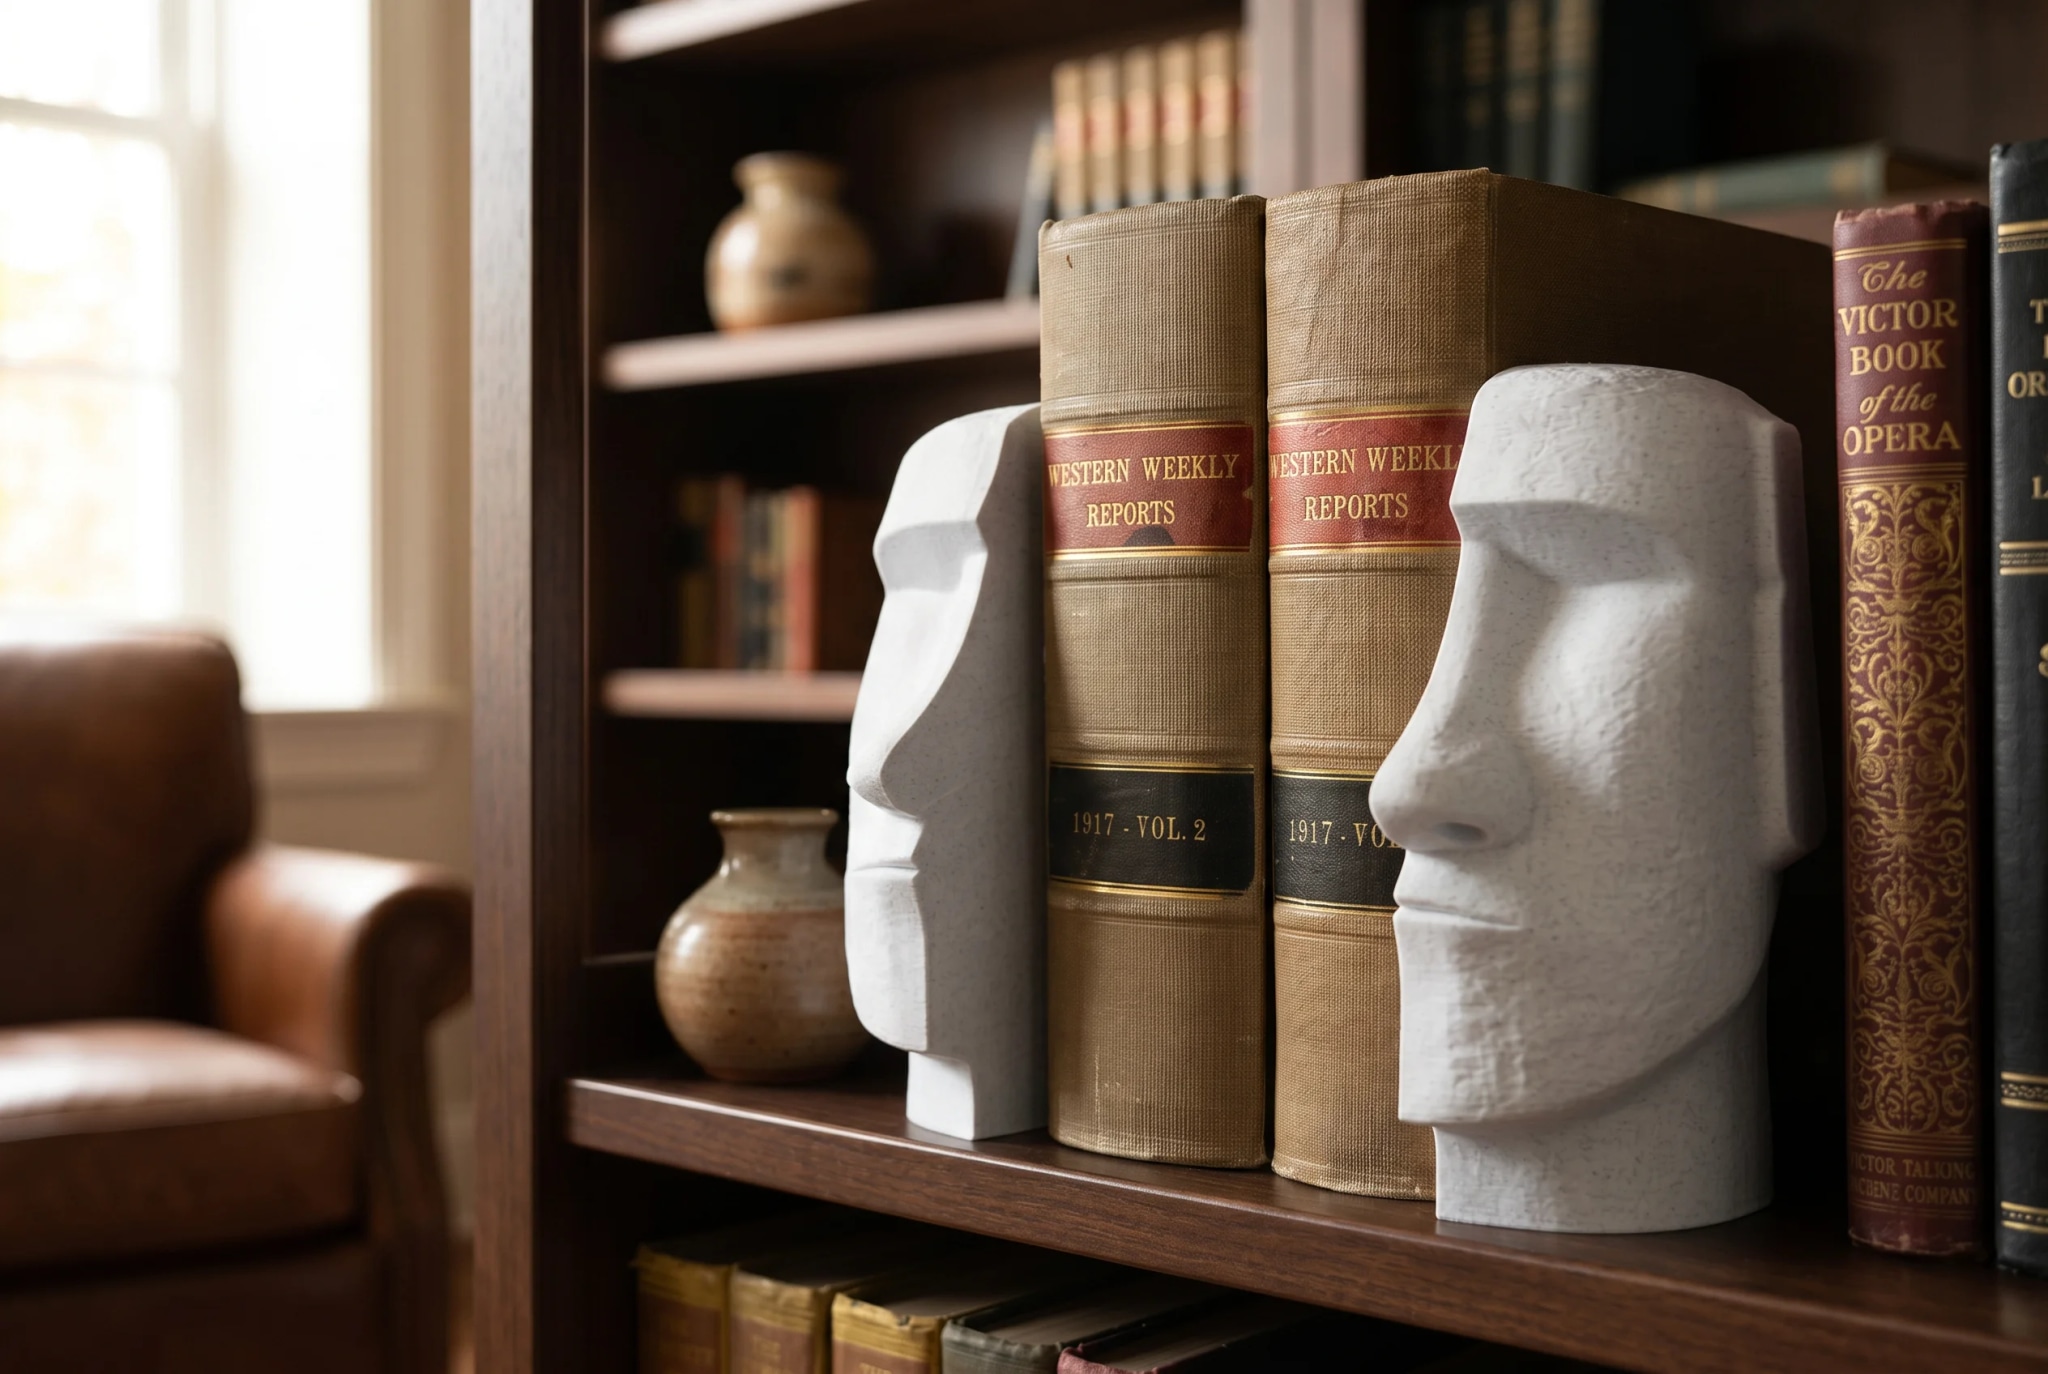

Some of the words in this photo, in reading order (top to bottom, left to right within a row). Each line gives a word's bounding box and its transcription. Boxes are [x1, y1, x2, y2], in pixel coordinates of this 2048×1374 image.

[1858, 260, 1927, 293] The
[1838, 299, 1959, 336] VICTOR
[1850, 340, 1946, 375] BOOK
[1859, 384, 1895, 423] of
[1890, 382, 1937, 413] the
[1843, 421, 1962, 456] OPERA
[1049, 458, 1130, 487] WESTERN
[1142, 454, 1239, 482] WEEKLY
[1270, 449, 1355, 479] WESTERN
[1367, 445, 1464, 473] WEEKL
[1086, 500, 1176, 527] REPORTS
[1304, 493, 1409, 521] REPORTS
[1073, 812, 1114, 837] 1917
[1137, 815, 1186, 841] VOL.
[1194, 819, 1206, 841] 2
[1289, 819, 1332, 845] 1917
